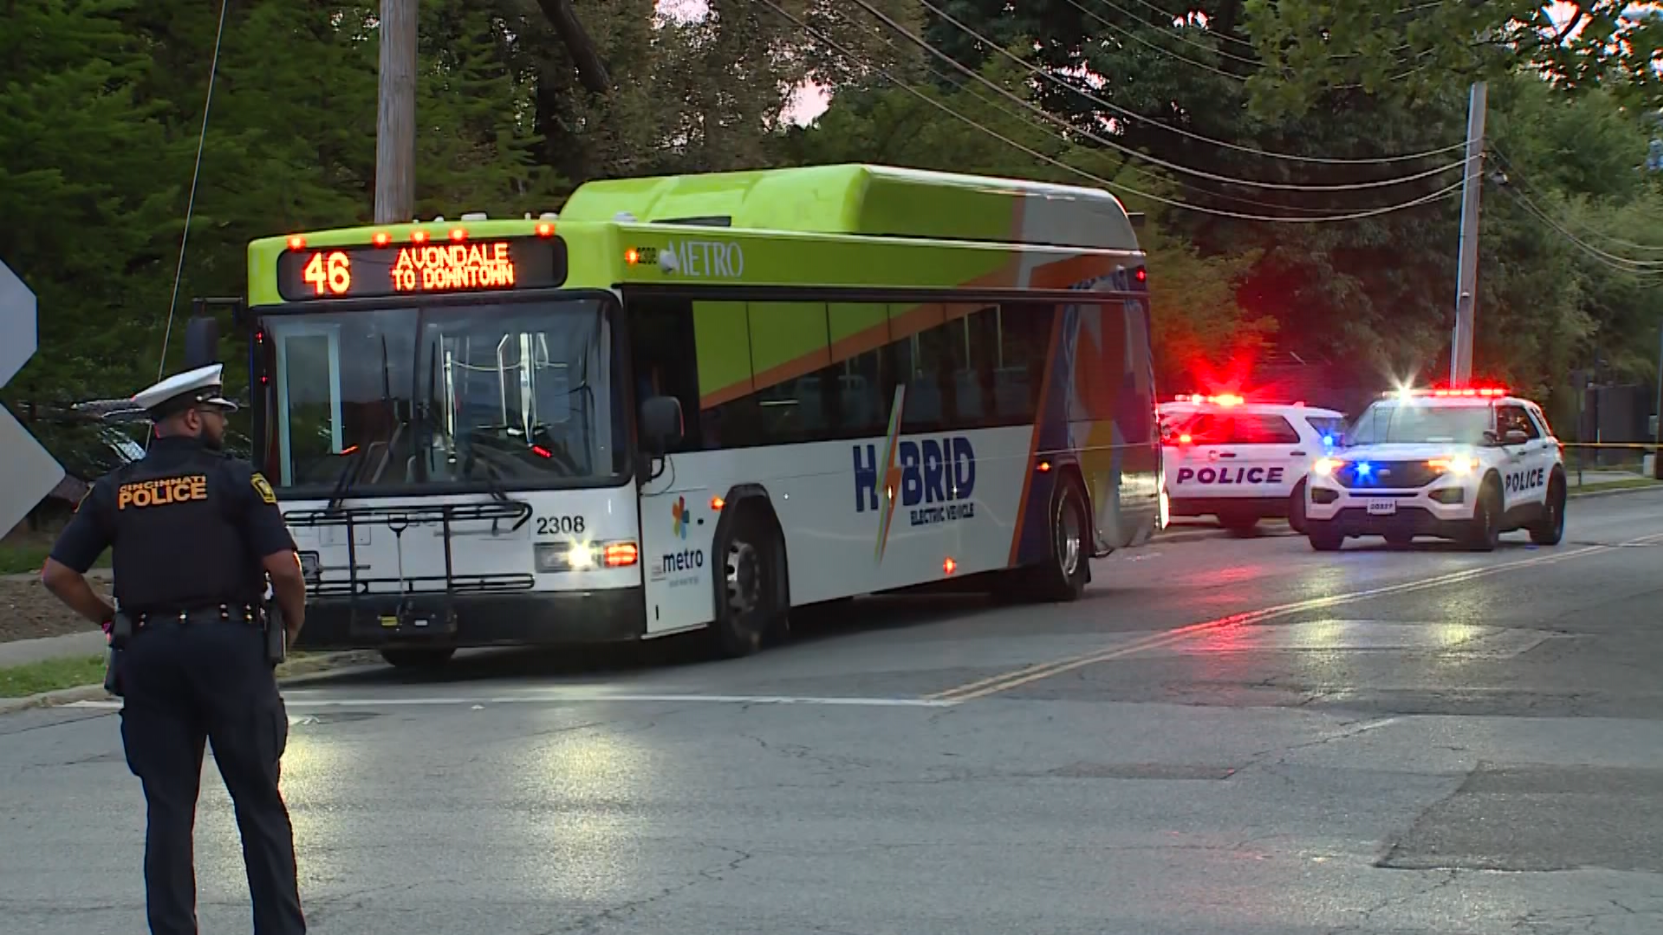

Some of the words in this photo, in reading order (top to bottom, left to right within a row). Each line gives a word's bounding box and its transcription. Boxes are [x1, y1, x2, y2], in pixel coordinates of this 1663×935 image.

[396, 243, 509, 269] AVONDALE
[666, 240, 744, 277] METRO
[304, 251, 351, 294] 46
[391, 268, 416, 291] TO
[422, 263, 514, 289] DOWNTOWN
[118, 474, 208, 493] CINCINNATI
[853, 436, 976, 513] HBRID
[1176, 467, 1284, 484] POLICE
[1505, 467, 1544, 492] POLICE
[118, 482, 208, 510] POLICE
[536, 515, 585, 535] 2308
[910, 507, 945, 526] ELECTRIC
[662, 548, 704, 574] metro
